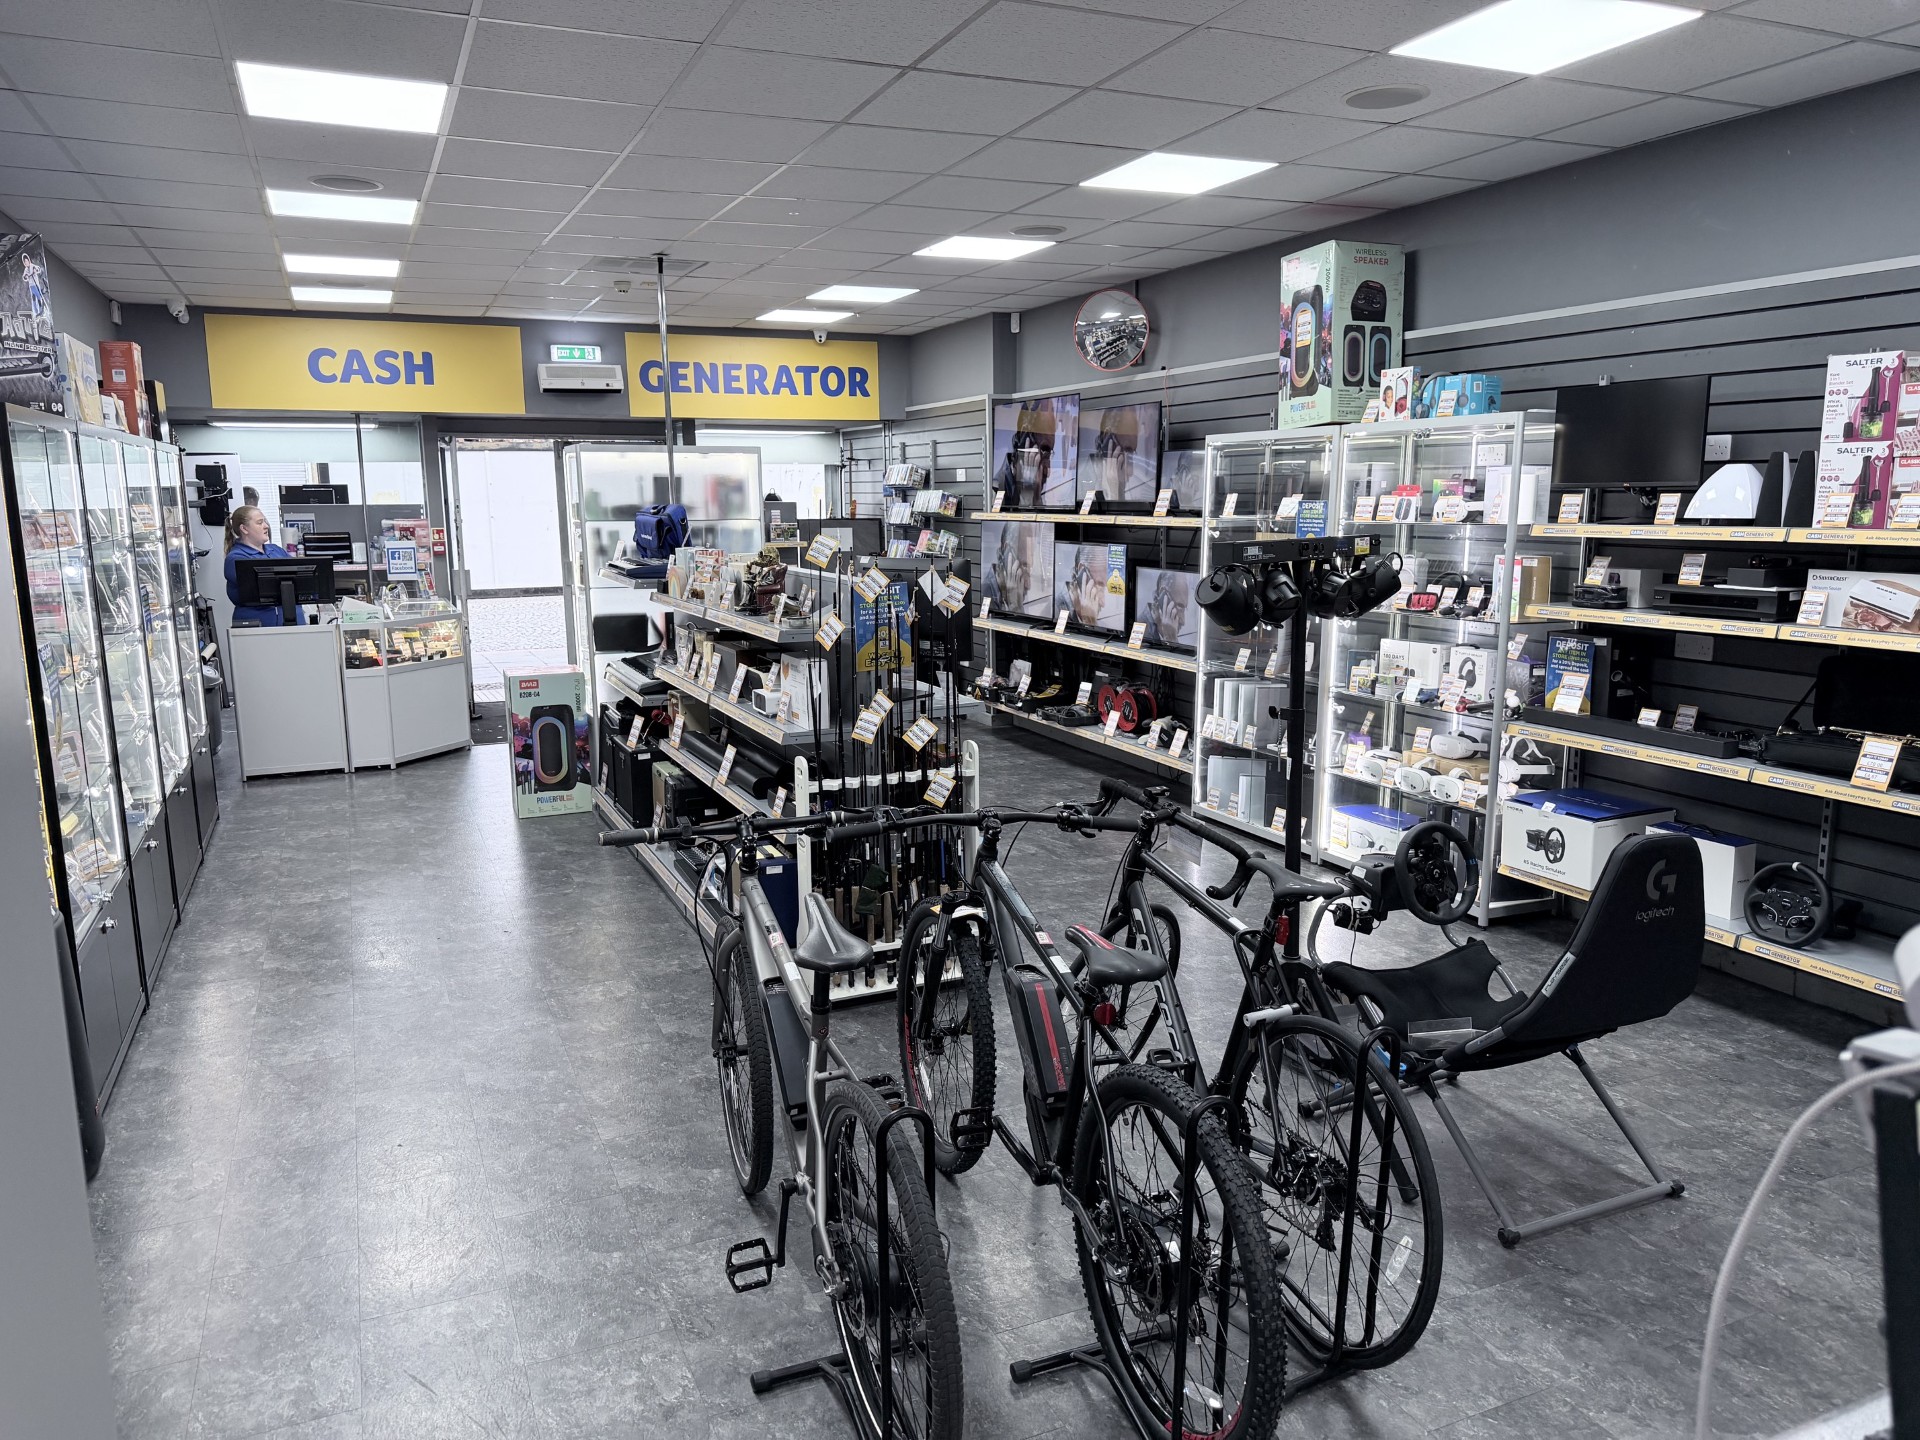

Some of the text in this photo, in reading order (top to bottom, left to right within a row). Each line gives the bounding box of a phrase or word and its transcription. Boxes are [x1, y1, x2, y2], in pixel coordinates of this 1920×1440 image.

[1356, 248, 1387, 256] WIRELESS
[1354, 256, 1388, 266] SPEAKER
[4, 340, 24, 350] INLINE
[1846, 358, 1882, 367] SALTER
[308, 347, 870, 397] CASH GENERATOR
[1556, 641, 1589, 651] DEPOSIT
[1769, 777, 1814, 790] CASH GENERATOR
[537, 795, 565, 804] POWERFUL
[1892, 801, 1909, 809] CASH
[1530, 861, 1544, 870] Racing
[1545, 865, 1566, 875] Simulator
[1636, 905, 1674, 922] logitech
[1756, 946, 1800, 964] CASH GENERATOR
[1875, 983, 1892, 993] CASH
